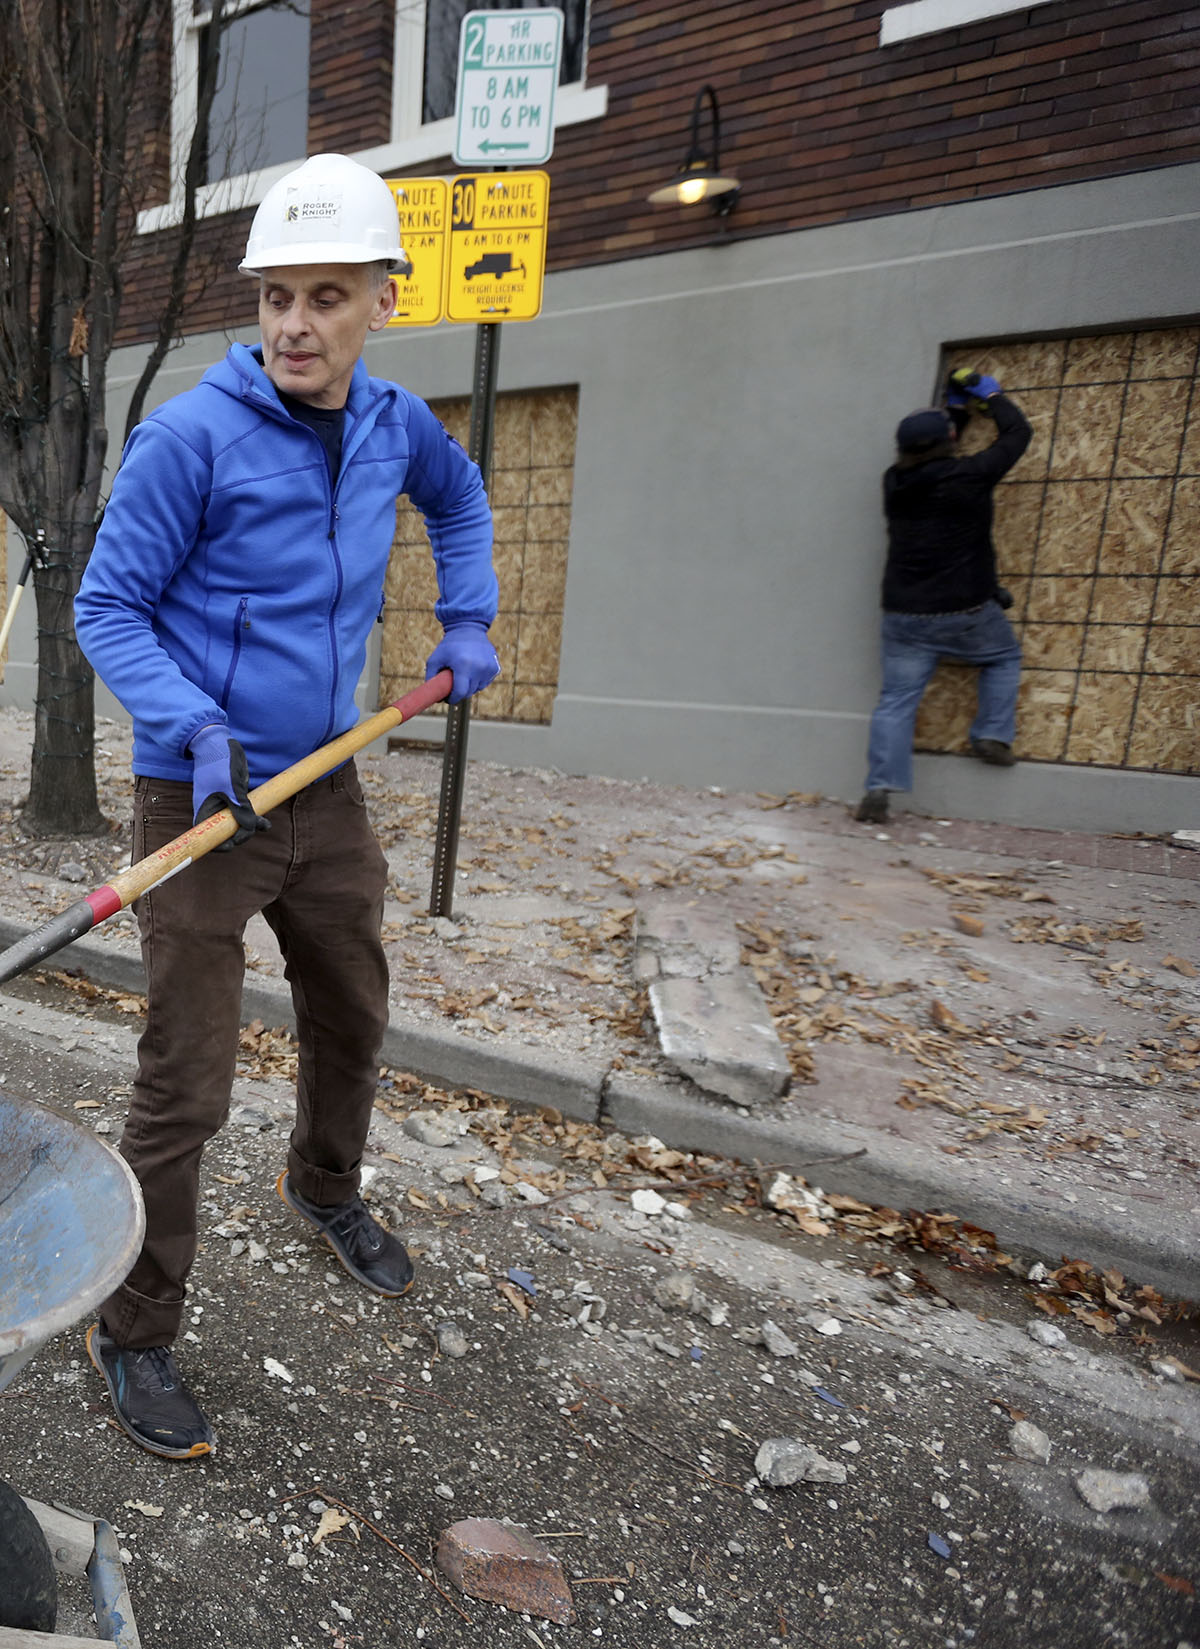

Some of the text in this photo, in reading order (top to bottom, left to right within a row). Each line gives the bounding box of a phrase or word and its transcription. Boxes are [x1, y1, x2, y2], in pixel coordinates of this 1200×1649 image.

[511, 20, 531, 39] HR
[466, 23, 484, 61] 2
[486, 41, 552, 62] PARKING
[487, 76, 529, 99] 8 AM
[471, 105, 541, 128] TO 6 PM
[391, 187, 437, 206] INUTE
[487, 183, 535, 200] MINUTE
[302, 202, 334, 210] ROGER
[452, 184, 475, 224] 30
[481, 202, 537, 219] PARKING
[398, 209, 441, 228] RKING
[420, 235, 436, 248] AM
[464, 233, 531, 247] 6 AM TO 6 PM
[397, 295, 425, 306] EHICLE
